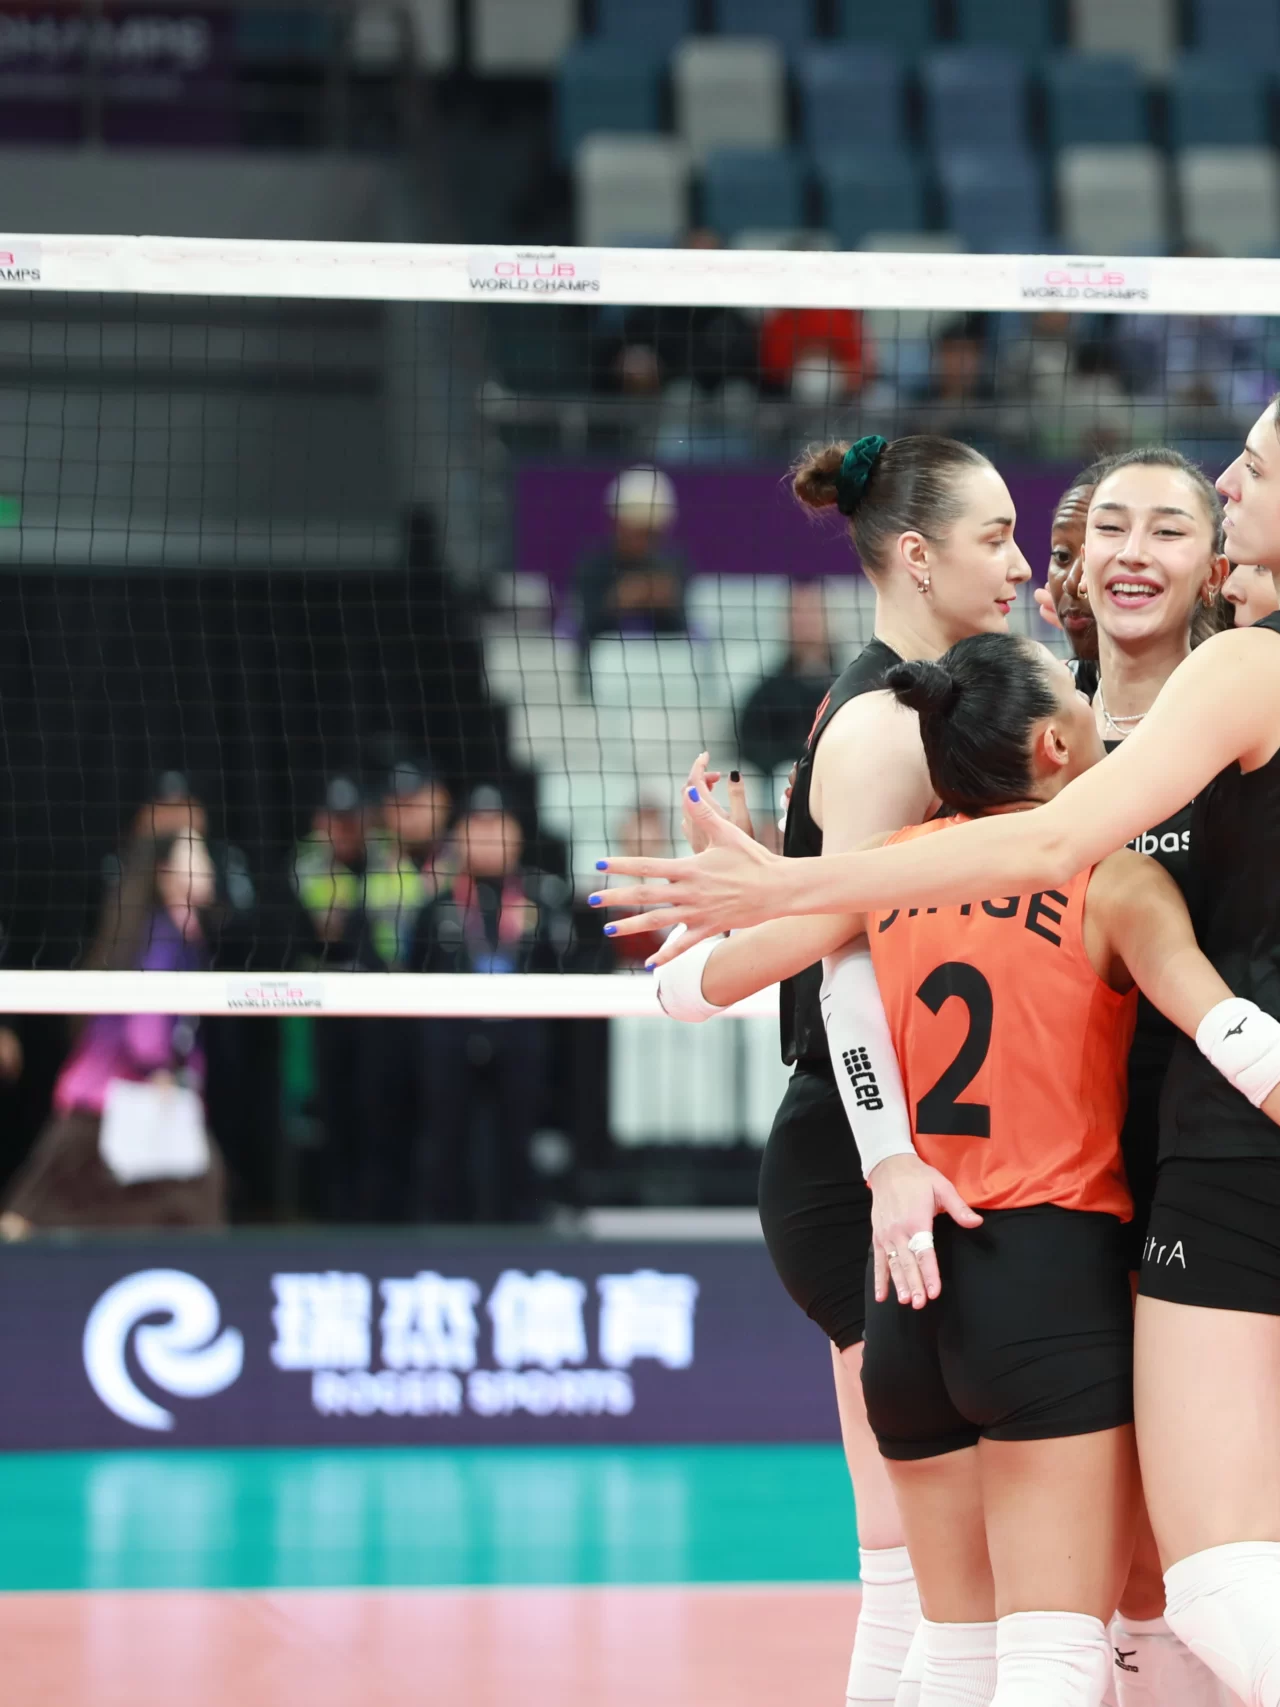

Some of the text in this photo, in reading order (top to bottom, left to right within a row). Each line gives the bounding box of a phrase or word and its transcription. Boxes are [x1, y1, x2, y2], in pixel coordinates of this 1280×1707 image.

[495, 262, 576, 277] CLUB
[1045, 271, 1125, 285] CLUB
[469, 278, 600, 291] WORLD CHAMPS
[1022, 287, 1149, 299] WORLD CHAMPS
[915, 961, 993, 1139] 2
[850, 1072, 884, 1111] cep
[1142, 1236, 1186, 1269] itrA
[311, 1368, 635, 1416] ROGER SPORTS
